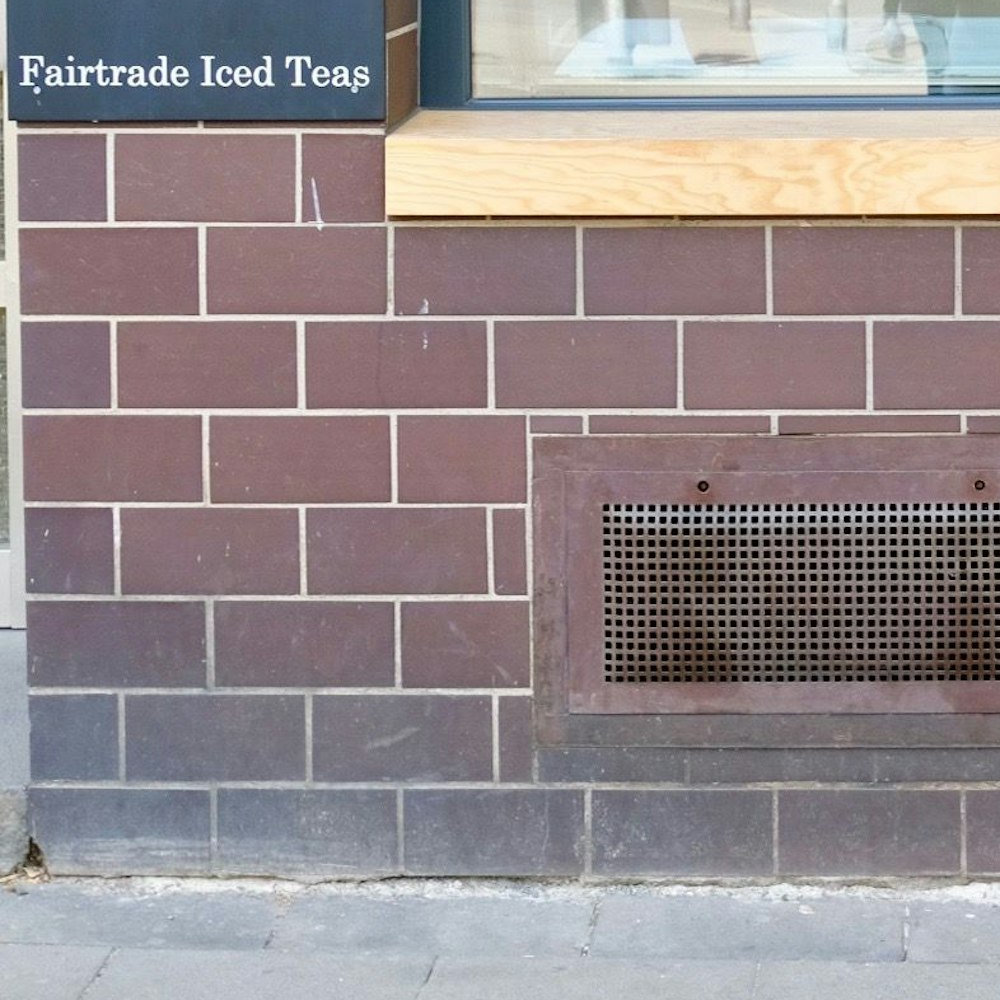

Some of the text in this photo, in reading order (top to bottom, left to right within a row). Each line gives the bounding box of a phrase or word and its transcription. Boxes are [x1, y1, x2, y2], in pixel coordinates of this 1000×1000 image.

[18, 55, 371, 87] Fairtrade Iced Teas
